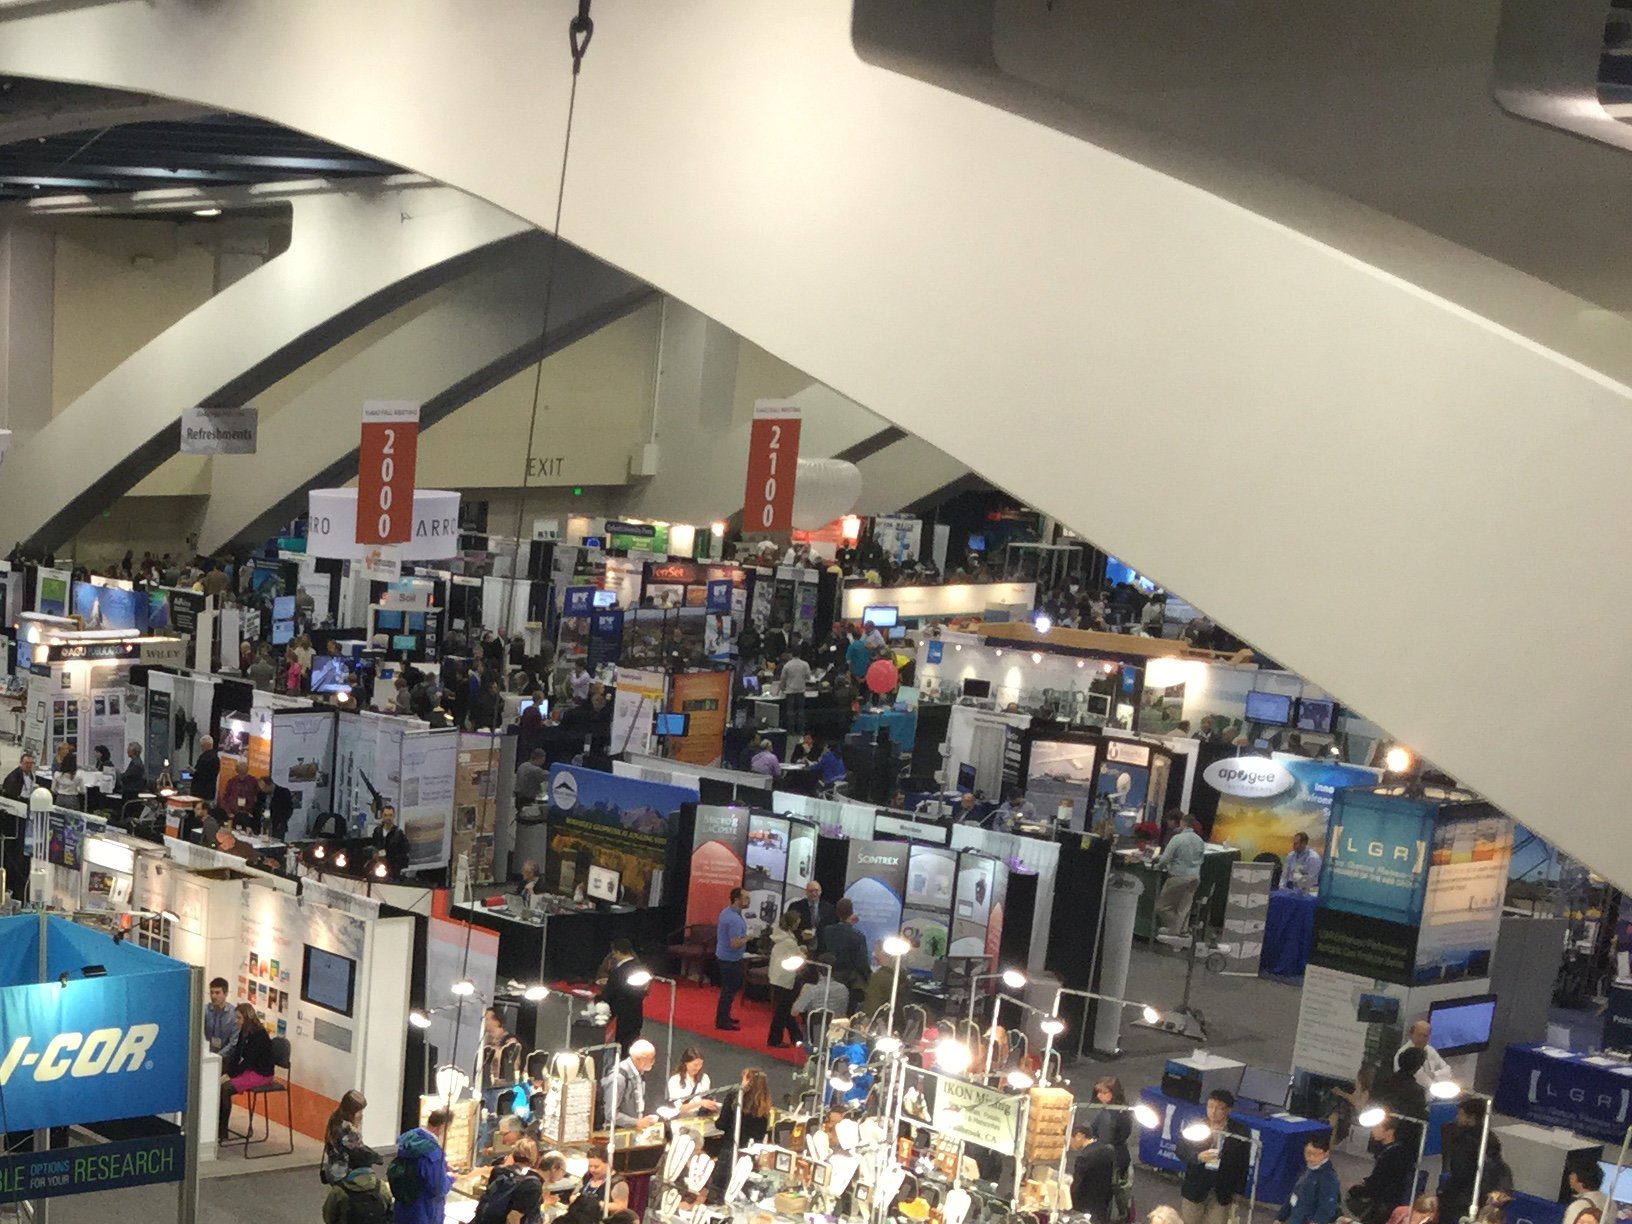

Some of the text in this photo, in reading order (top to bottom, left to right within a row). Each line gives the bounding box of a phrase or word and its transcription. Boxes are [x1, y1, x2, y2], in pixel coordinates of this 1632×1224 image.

[186, 426, 253, 441] Refreshments
[527, 457, 564, 477] EXIT
[762, 425, 780, 528] 2100
[377, 429, 395, 539] 2000
[147, 649, 180, 659] WILEY
[1218, 766, 1276, 785] apogee
[943, 1080, 972, 1102] IKON
[30, 1159, 70, 1177] OPTIONS
[74, 1147, 174, 1184] RESEARCH
[30, 1174, 69, 1190] FOR YOUR
